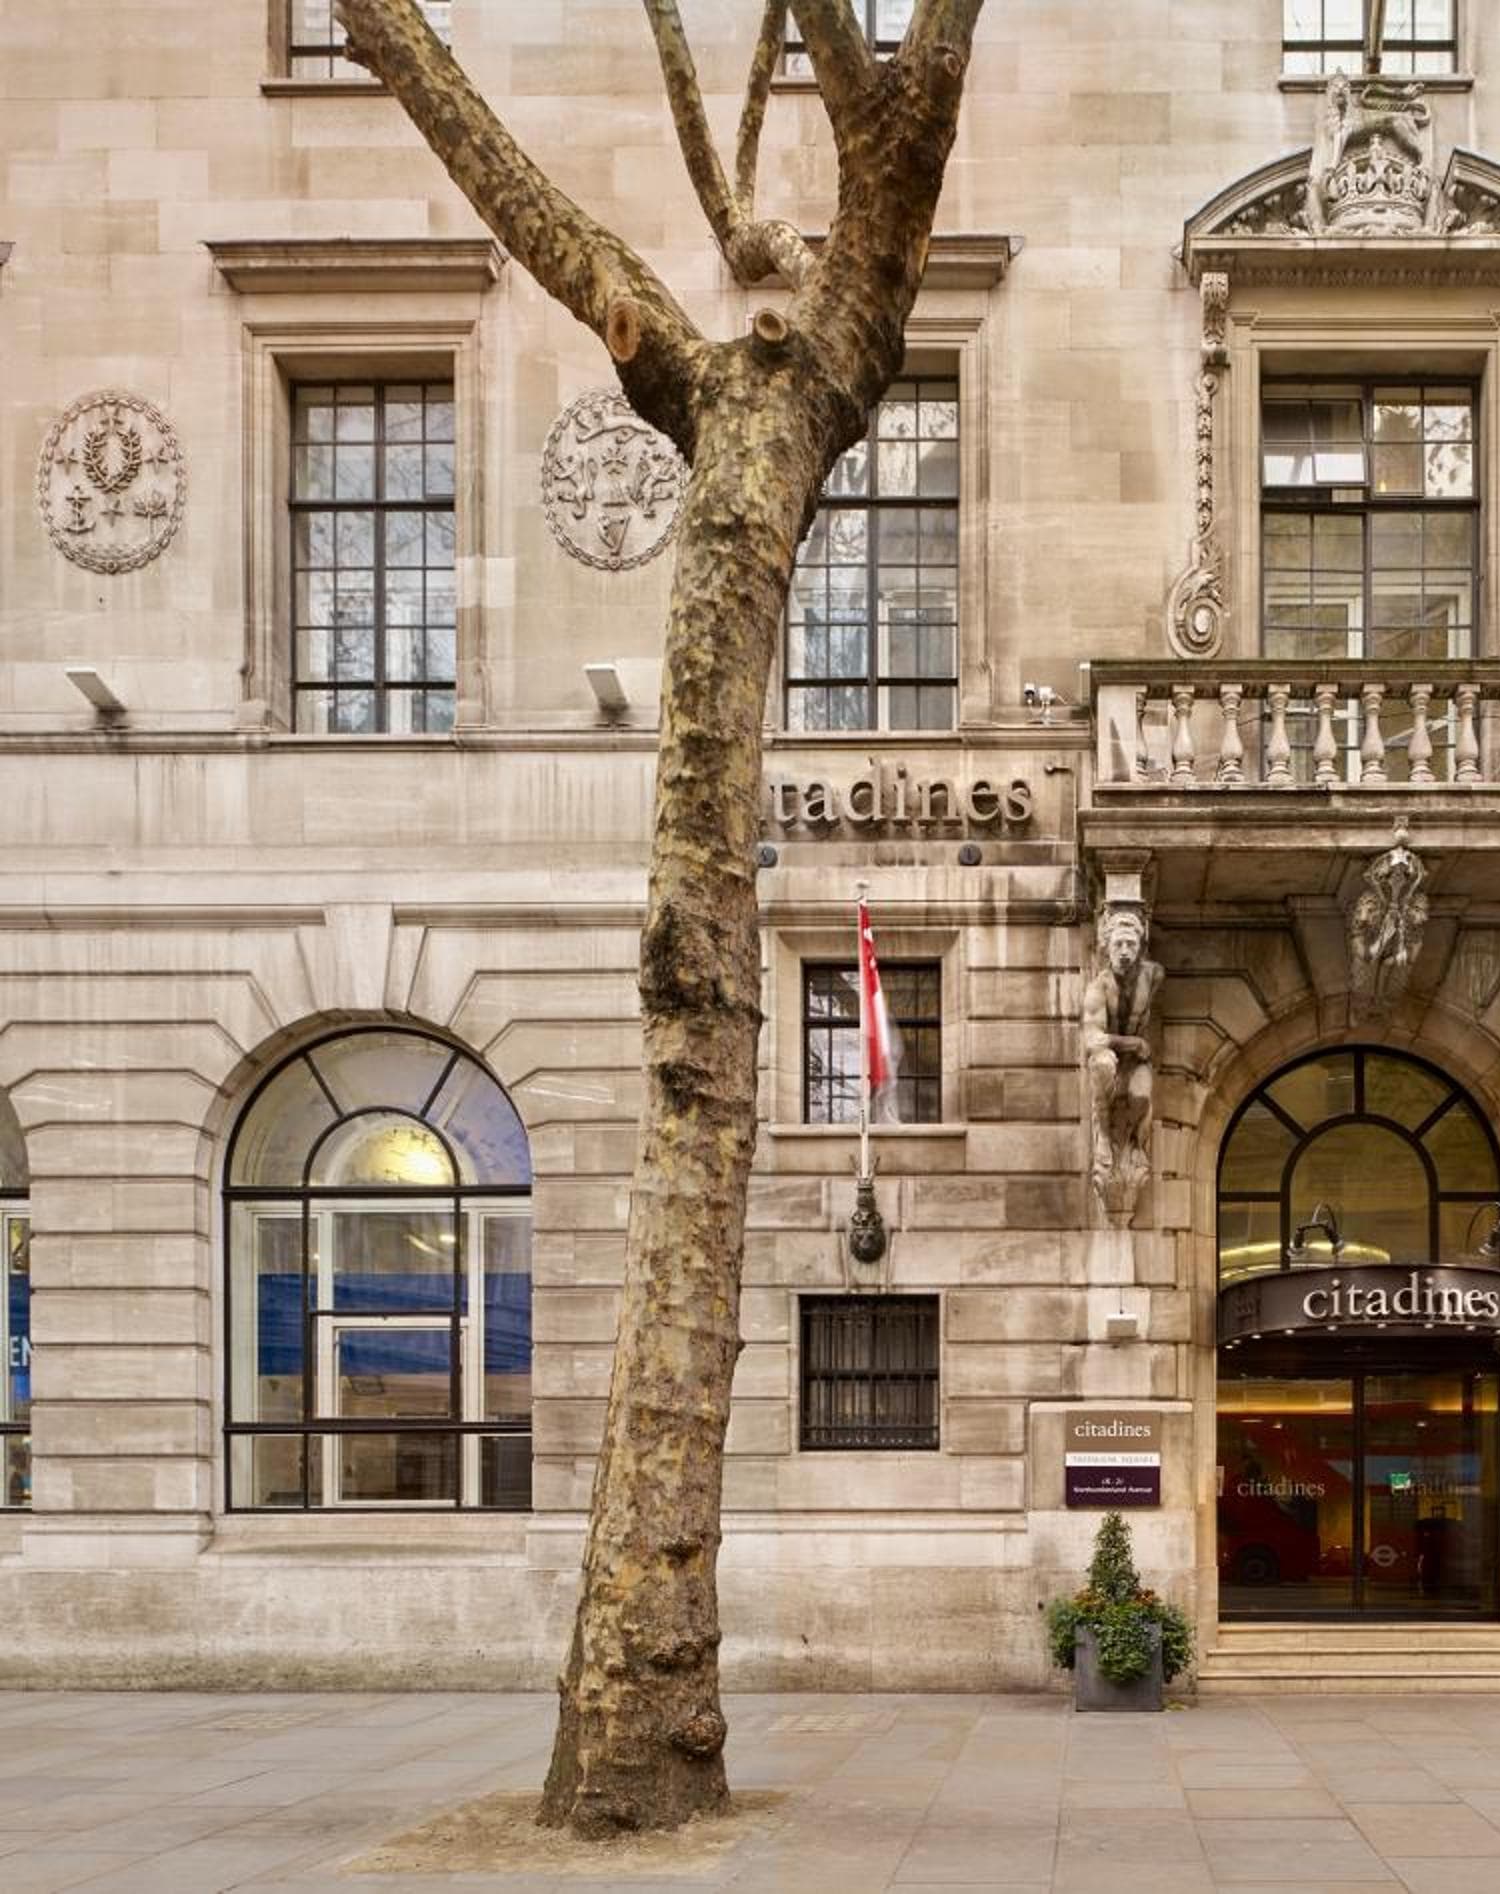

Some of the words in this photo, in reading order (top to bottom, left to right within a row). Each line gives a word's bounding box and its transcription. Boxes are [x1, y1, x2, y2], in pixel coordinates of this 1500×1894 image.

[762, 757, 1034, 828] tadines
[1302, 1271, 1500, 1320] citadines
[1074, 1419, 1152, 1438] citadines
[1237, 1474, 1326, 1497] citadines
